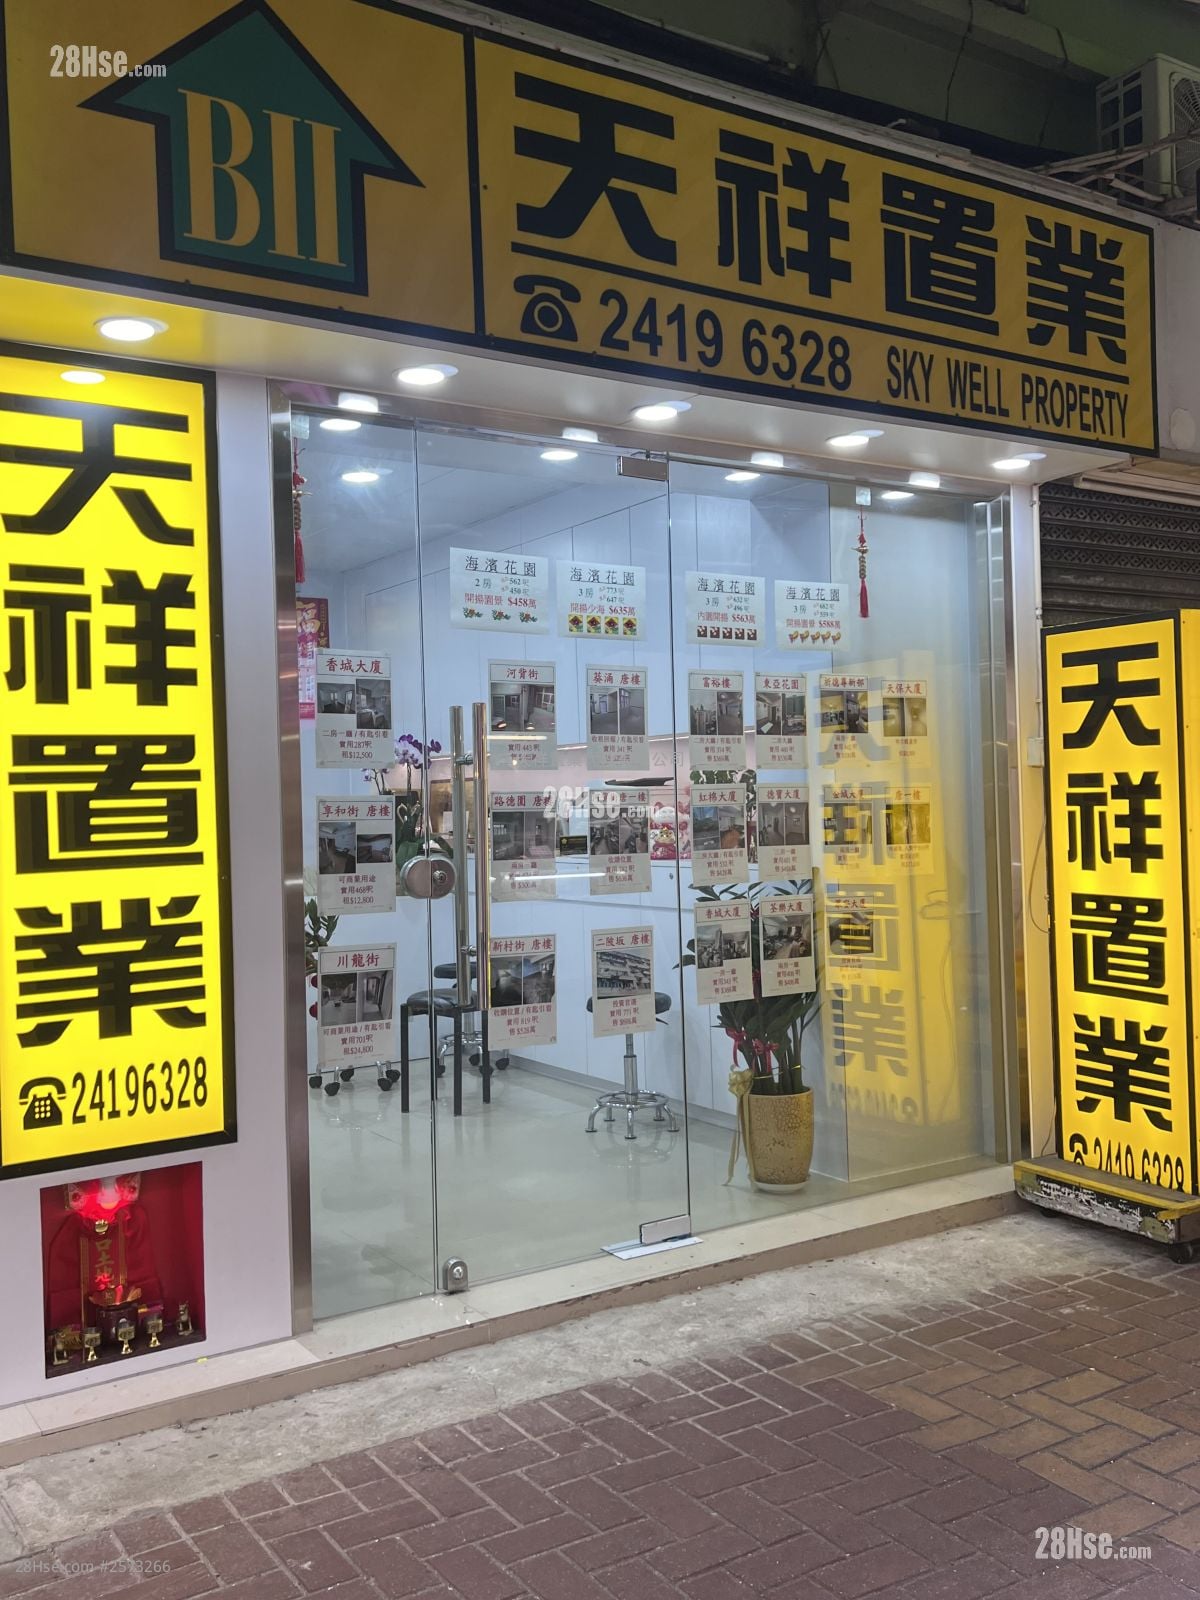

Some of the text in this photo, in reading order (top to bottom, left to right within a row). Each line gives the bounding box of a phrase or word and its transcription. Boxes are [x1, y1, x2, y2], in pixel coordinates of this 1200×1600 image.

[513, 71, 1127, 365] 天祥置業
[599, 289, 852, 392] 2419 6328
[886, 345, 1129, 440] SKY WELL PROPERTY
[465, 556, 536, 577] 海濱花園
[570, 567, 635, 586] 海濱花園
[697, 576, 755, 595] 海濱花園
[785, 586, 840, 601] 海濱花園
[326, 657, 383, 675] 香城大廈
[620, 673, 641, 685] 唐樓
[0, 392, 206, 1048] 天祥置業
[322, 804, 391, 818] 享和街 唐樓
[1060, 641, 1173, 1132] 天祥置業
[492, 938, 553, 953] 新村街 唐樓
[630, 933, 650, 945] 唐樓
[337, 952, 379, 968] 川龍街
[71, 1056, 208, 1125] 24196328
